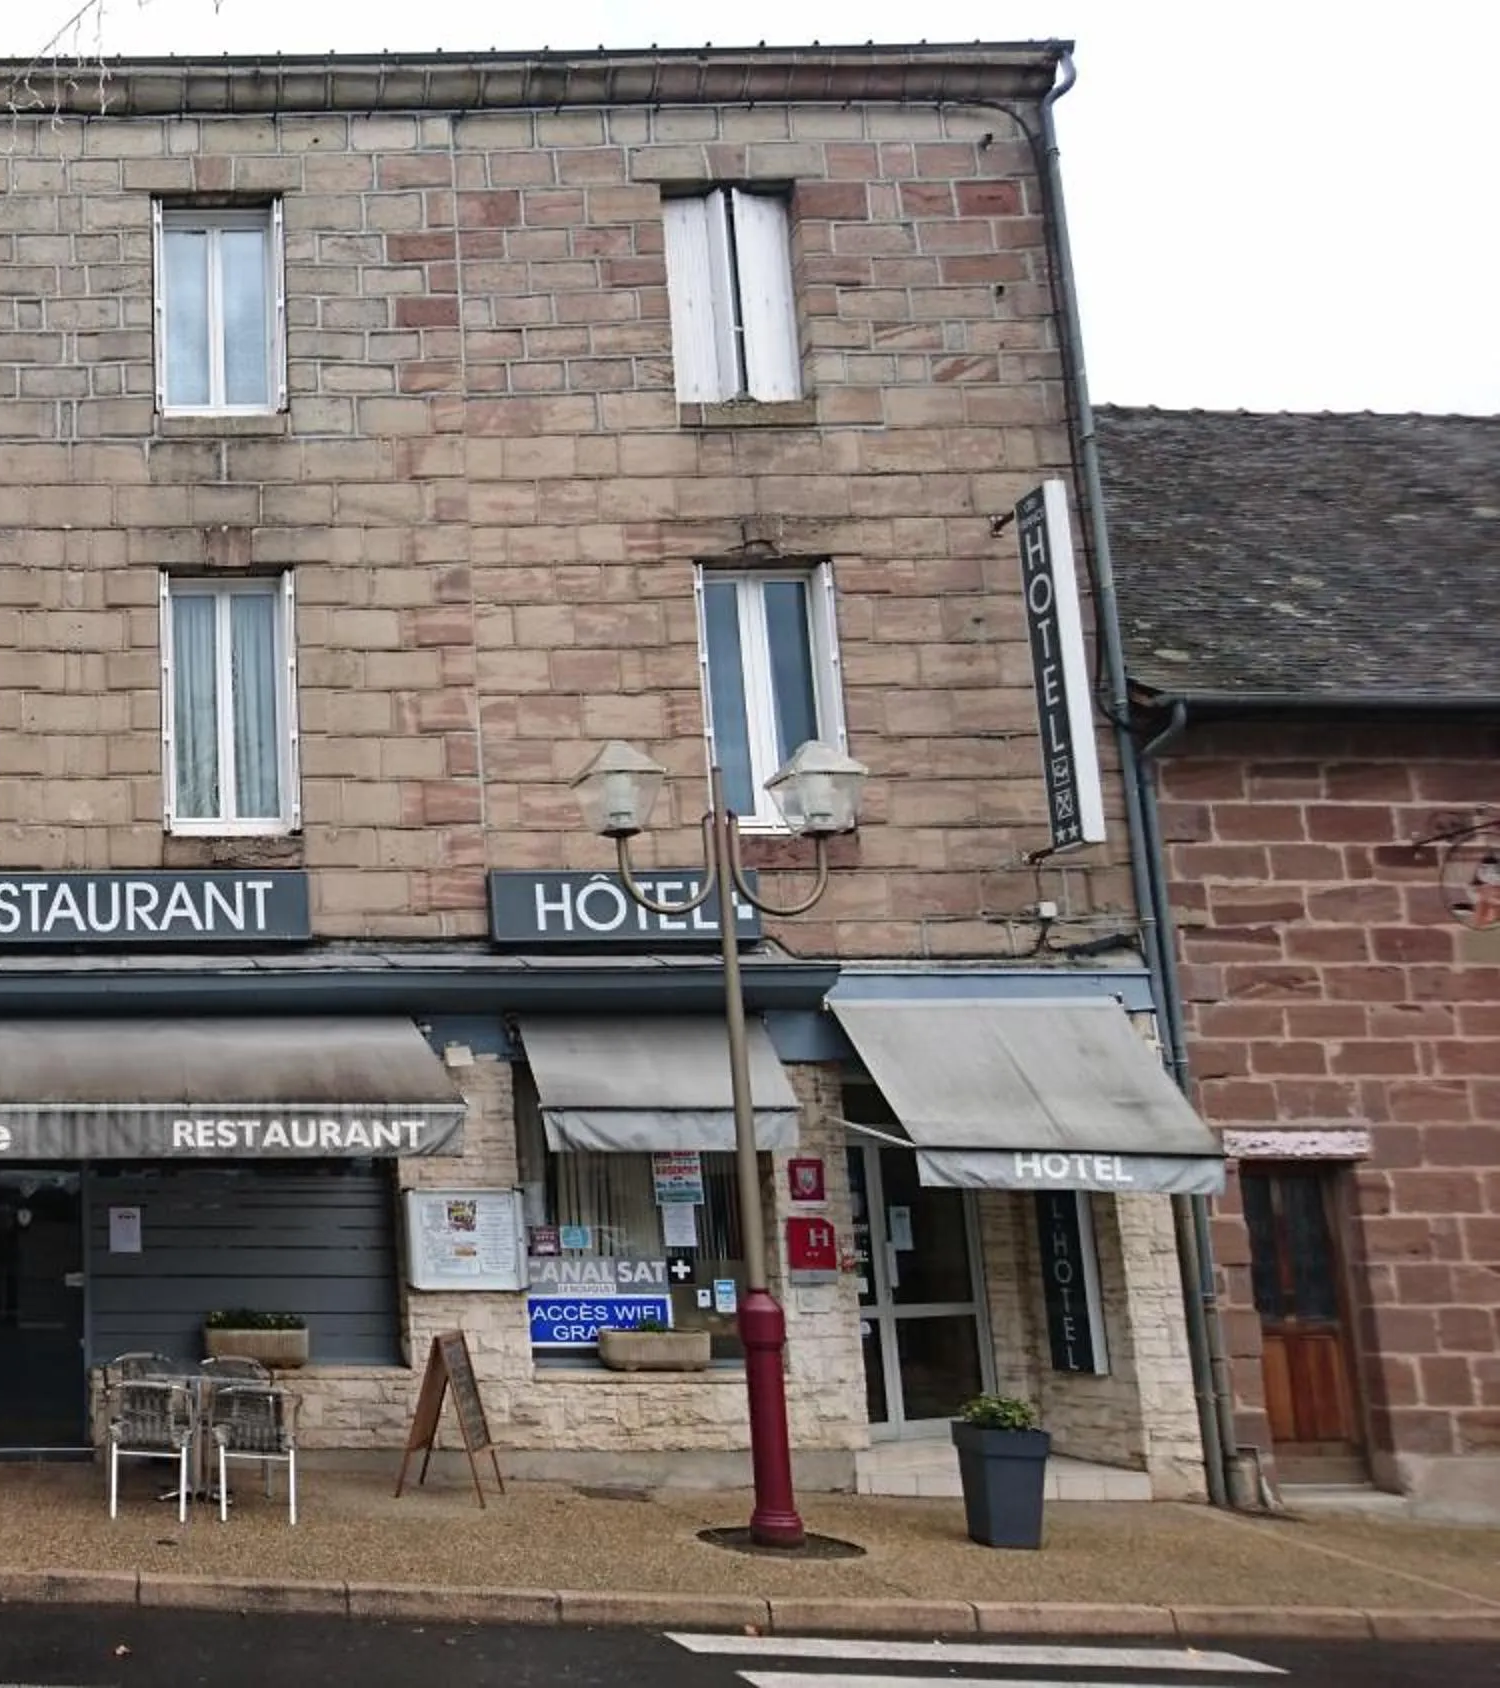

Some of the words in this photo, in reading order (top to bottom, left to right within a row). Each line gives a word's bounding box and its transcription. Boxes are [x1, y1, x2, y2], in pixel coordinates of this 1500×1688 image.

[1025, 525, 1066, 752] HOTEL
[534, 873, 719, 931] HÔTEL
[172, 1119, 425, 1148] RESTAURANT
[1014, 1151, 1134, 1182] HOTEL
[809, 1228, 831, 1247] H
[532, 1302, 609, 1321] ACCÈS
[614, 1305, 661, 1320] WIFI
